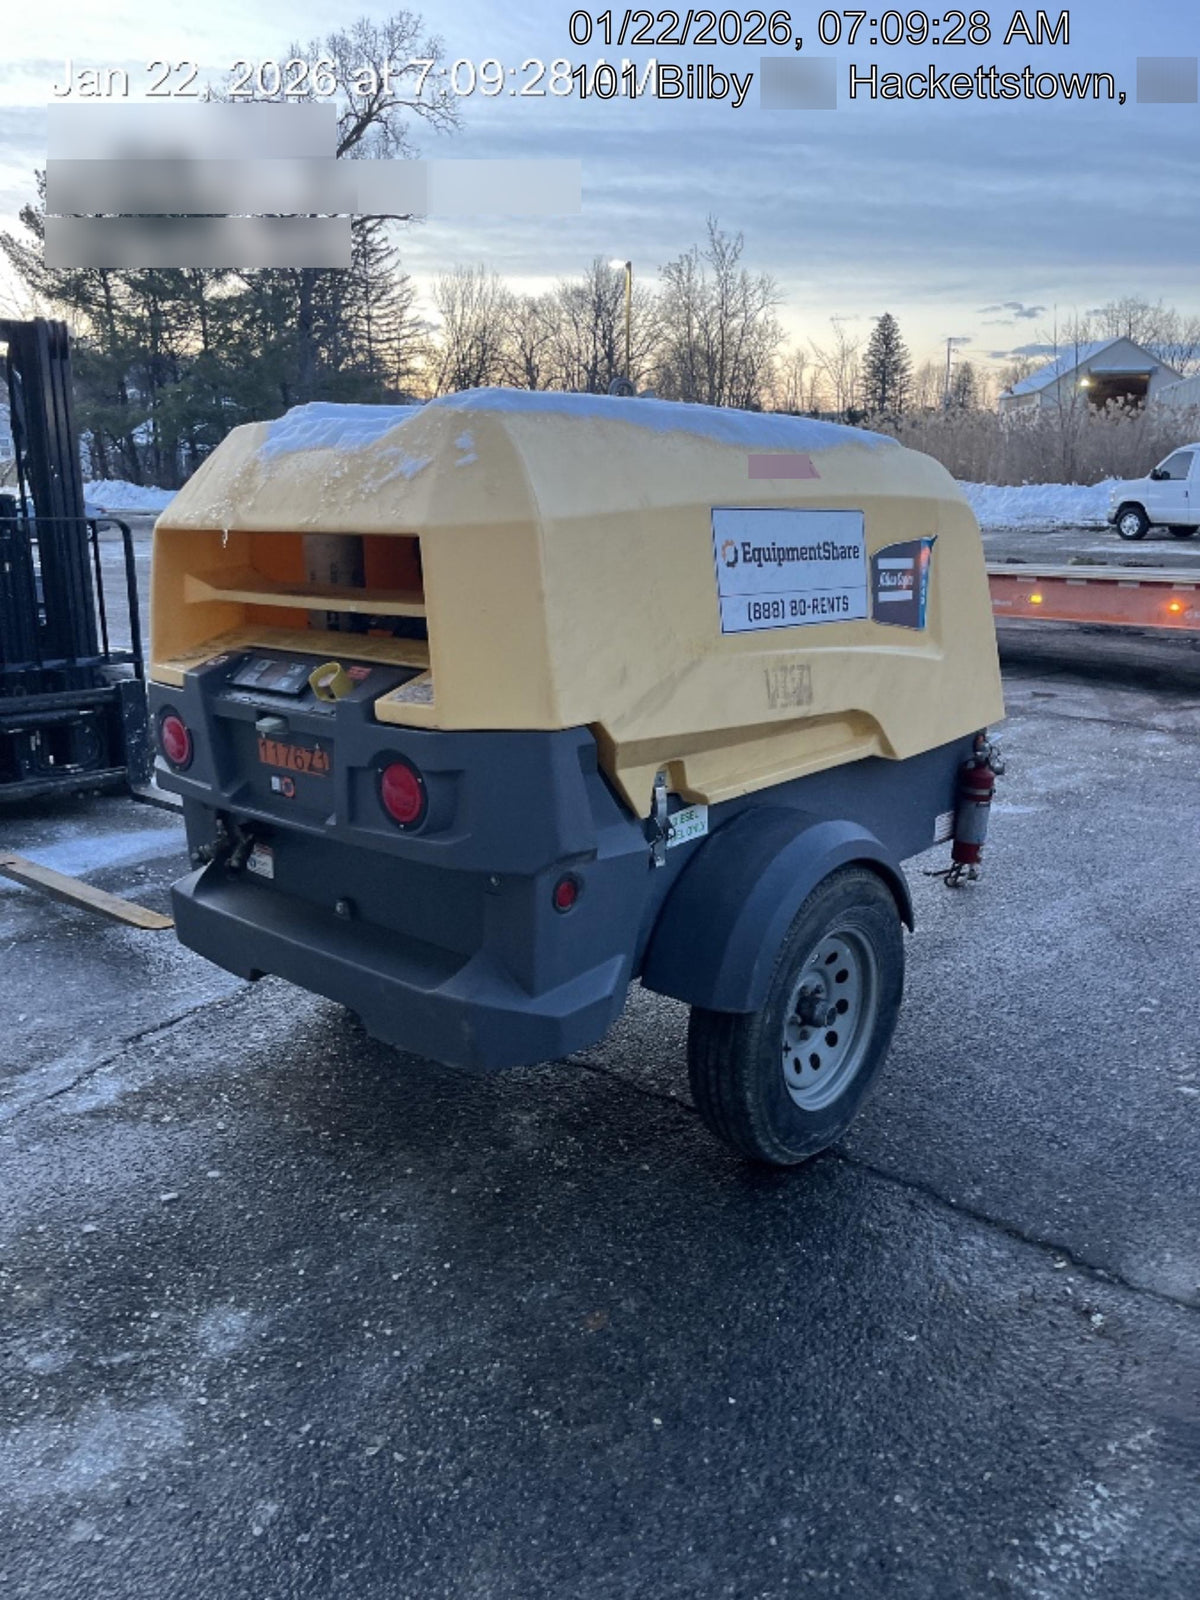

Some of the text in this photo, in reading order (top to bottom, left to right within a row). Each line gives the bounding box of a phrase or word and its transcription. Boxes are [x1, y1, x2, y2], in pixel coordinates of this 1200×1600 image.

[741, 541, 860, 567] EquipmentShare
[747, 595, 849, 622] (888) 80-RENTS
